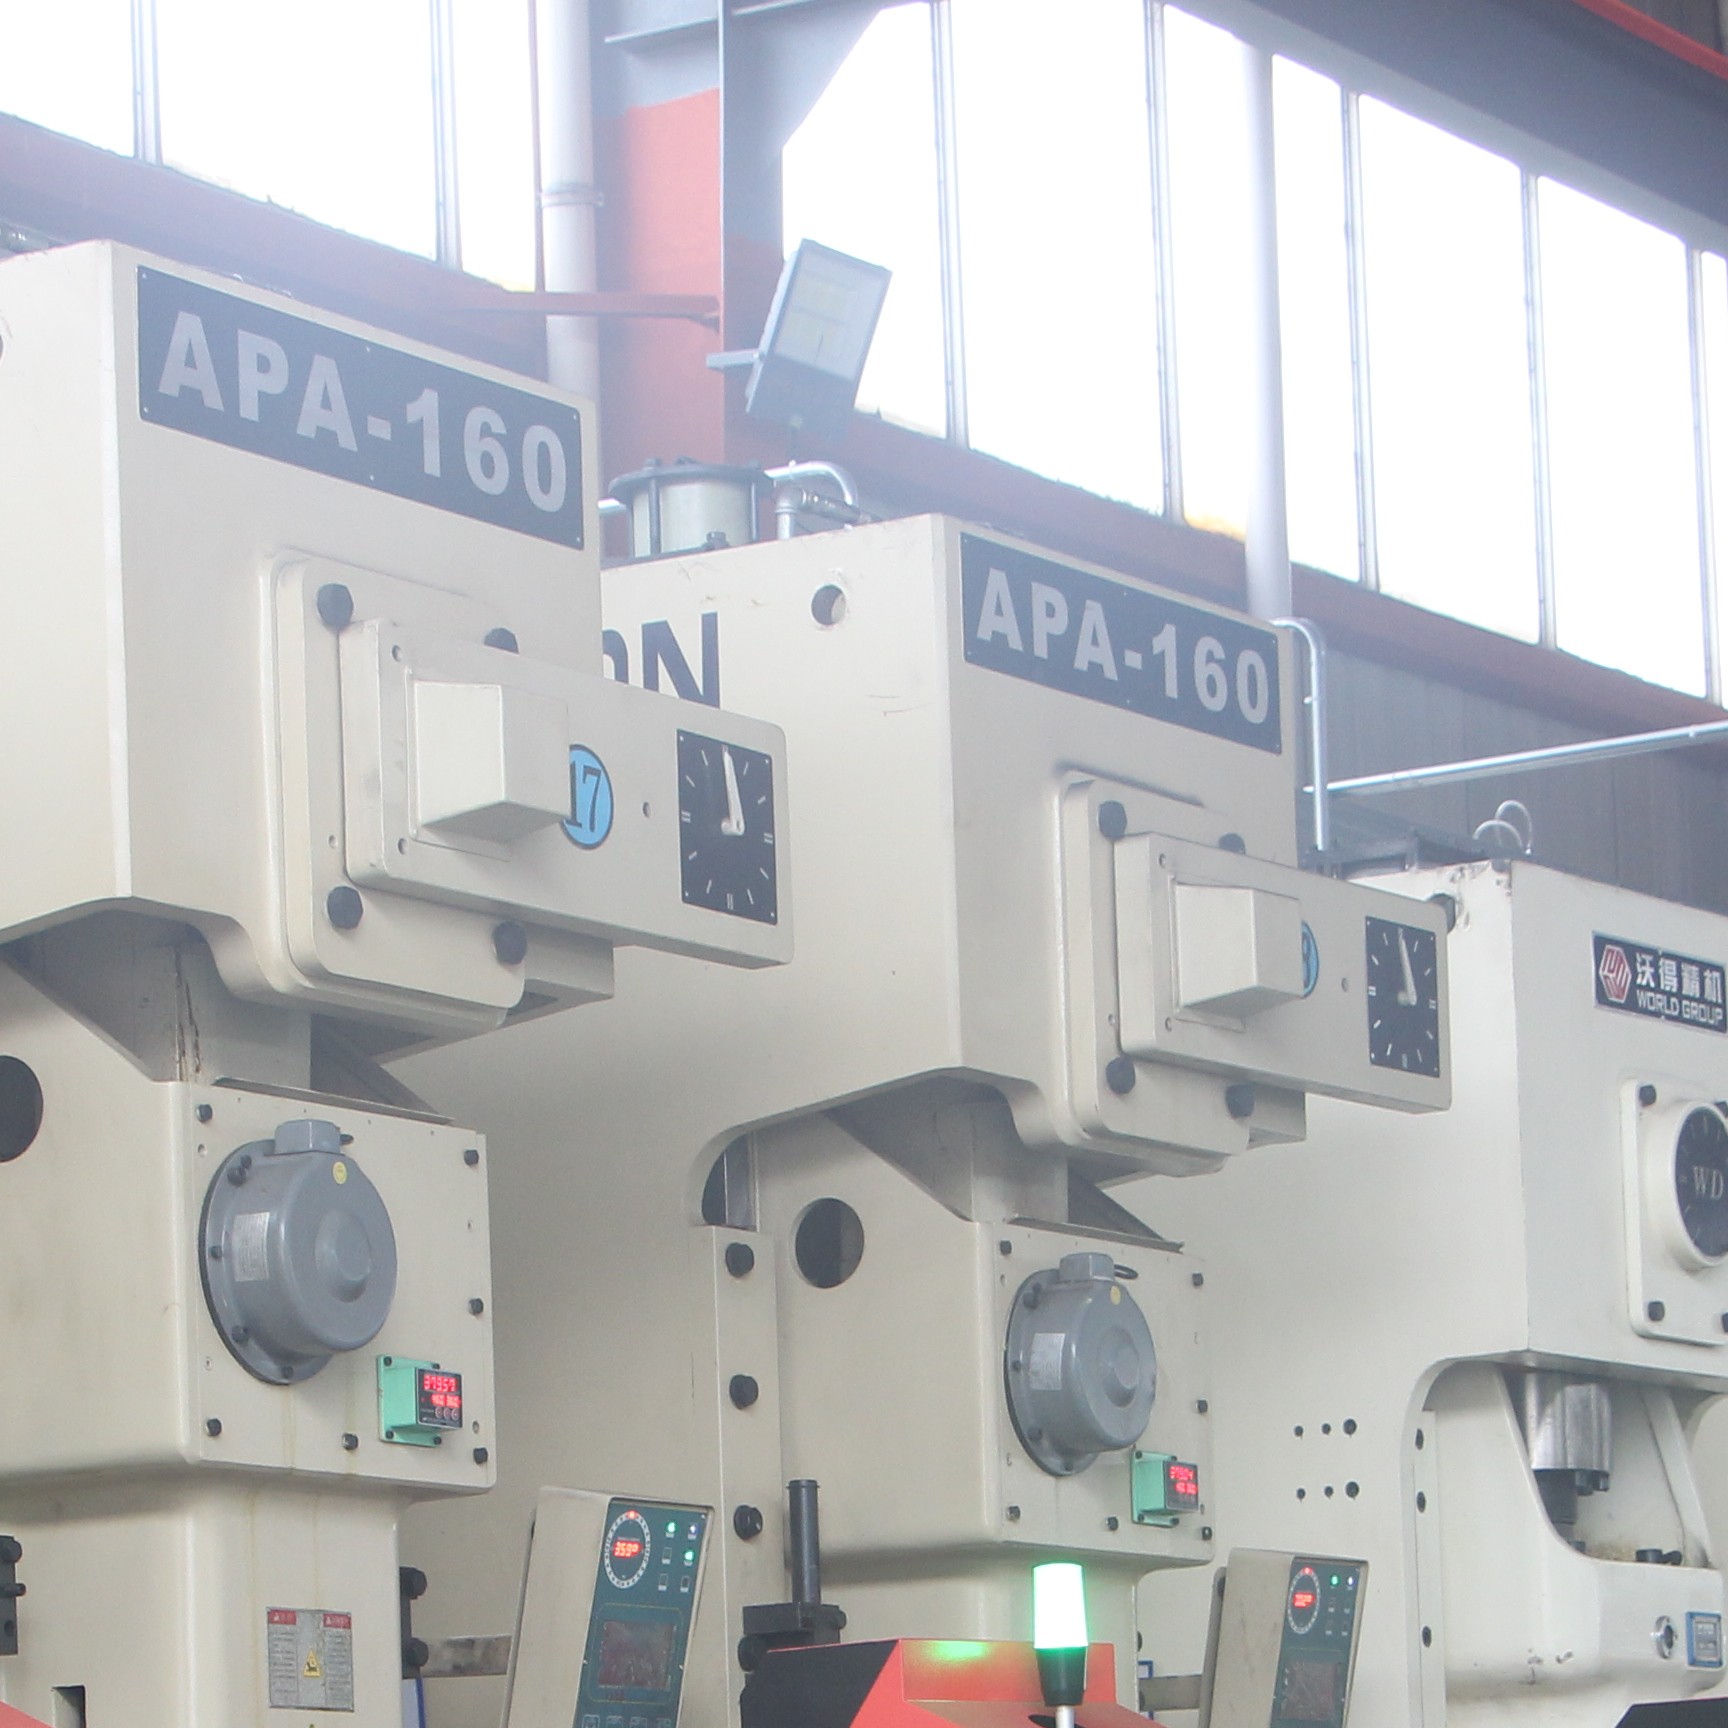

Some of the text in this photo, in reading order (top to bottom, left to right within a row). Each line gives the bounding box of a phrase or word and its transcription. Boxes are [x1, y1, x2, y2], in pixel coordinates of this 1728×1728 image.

[157, 310, 566, 514] APA-160
[975, 567, 1269, 725] APA-160
[566, 761, 602, 833] 17
[1635, 952, 1722, 1003] 沃得精机
[1636, 989, 1723, 1025] WORLD GROUP
